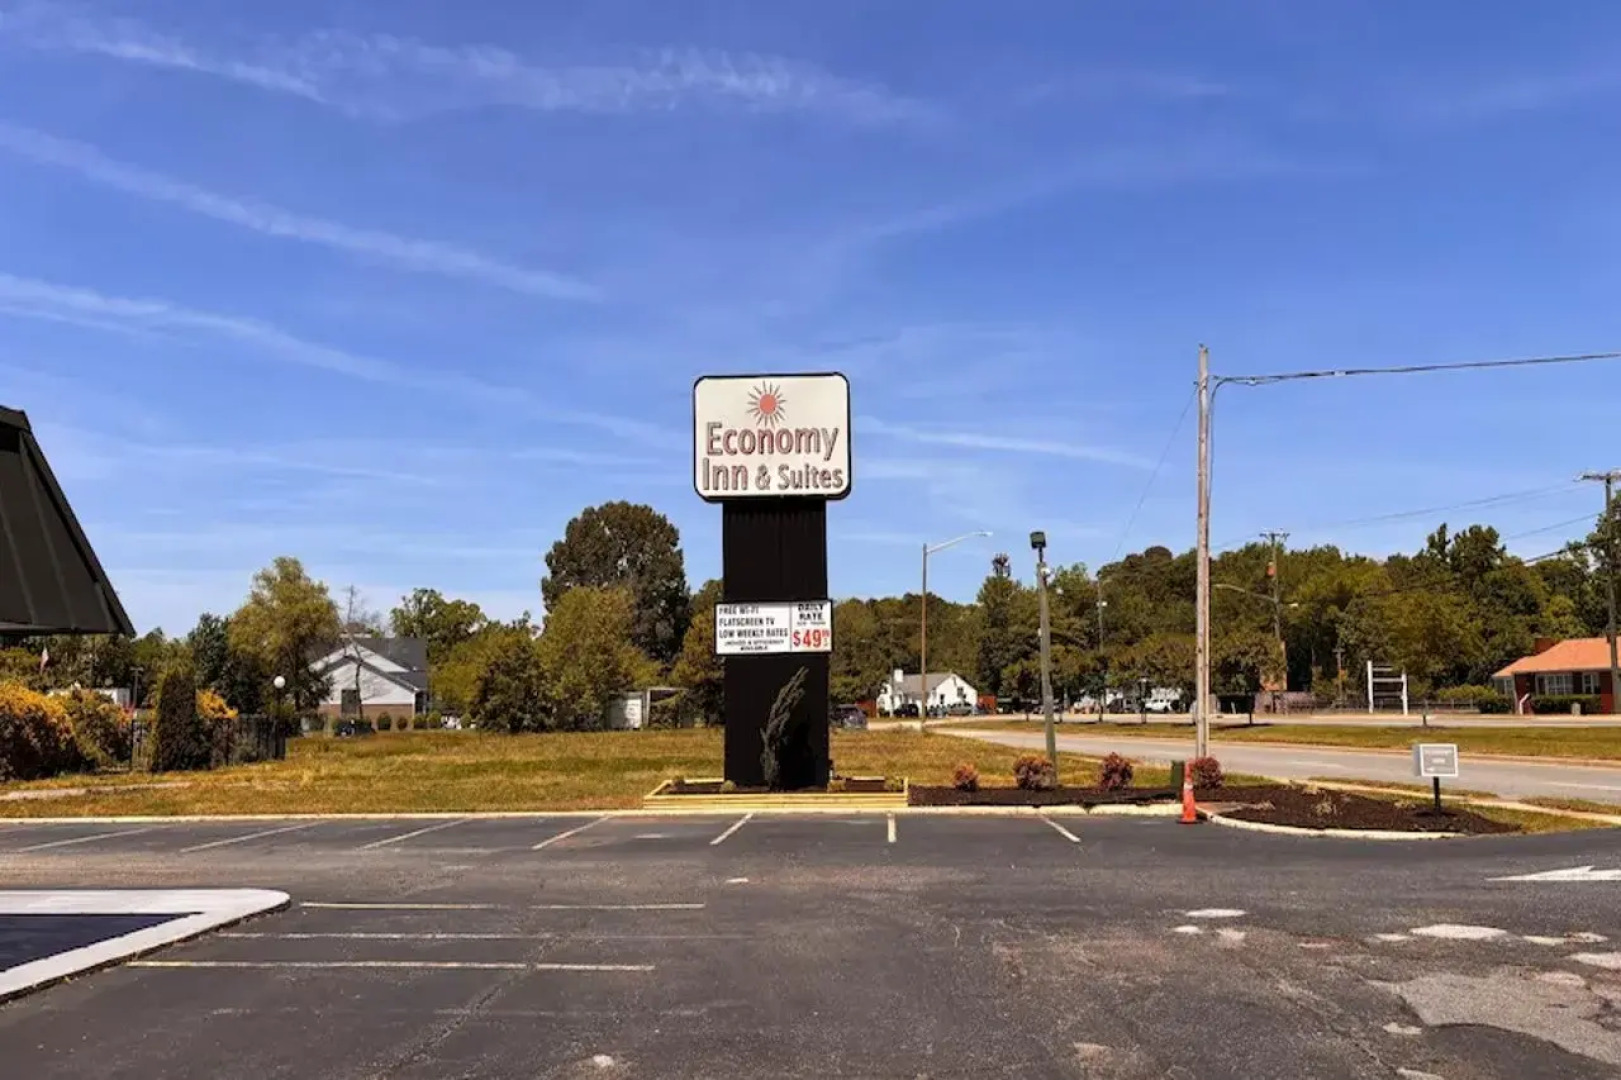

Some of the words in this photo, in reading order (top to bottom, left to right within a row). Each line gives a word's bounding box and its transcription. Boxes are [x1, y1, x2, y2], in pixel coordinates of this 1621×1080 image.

[706, 421, 839, 461] Economy
[702, 457, 749, 490] Inn
[755, 463, 771, 490] &
[777, 462, 844, 490] Suites
[719, 605, 737, 615] FREE
[719, 617, 763, 626] FLATSCREEN
[766, 616, 775, 625] TV
[719, 629, 734, 638] LOW
[737, 628, 764, 638] WEEKLY
